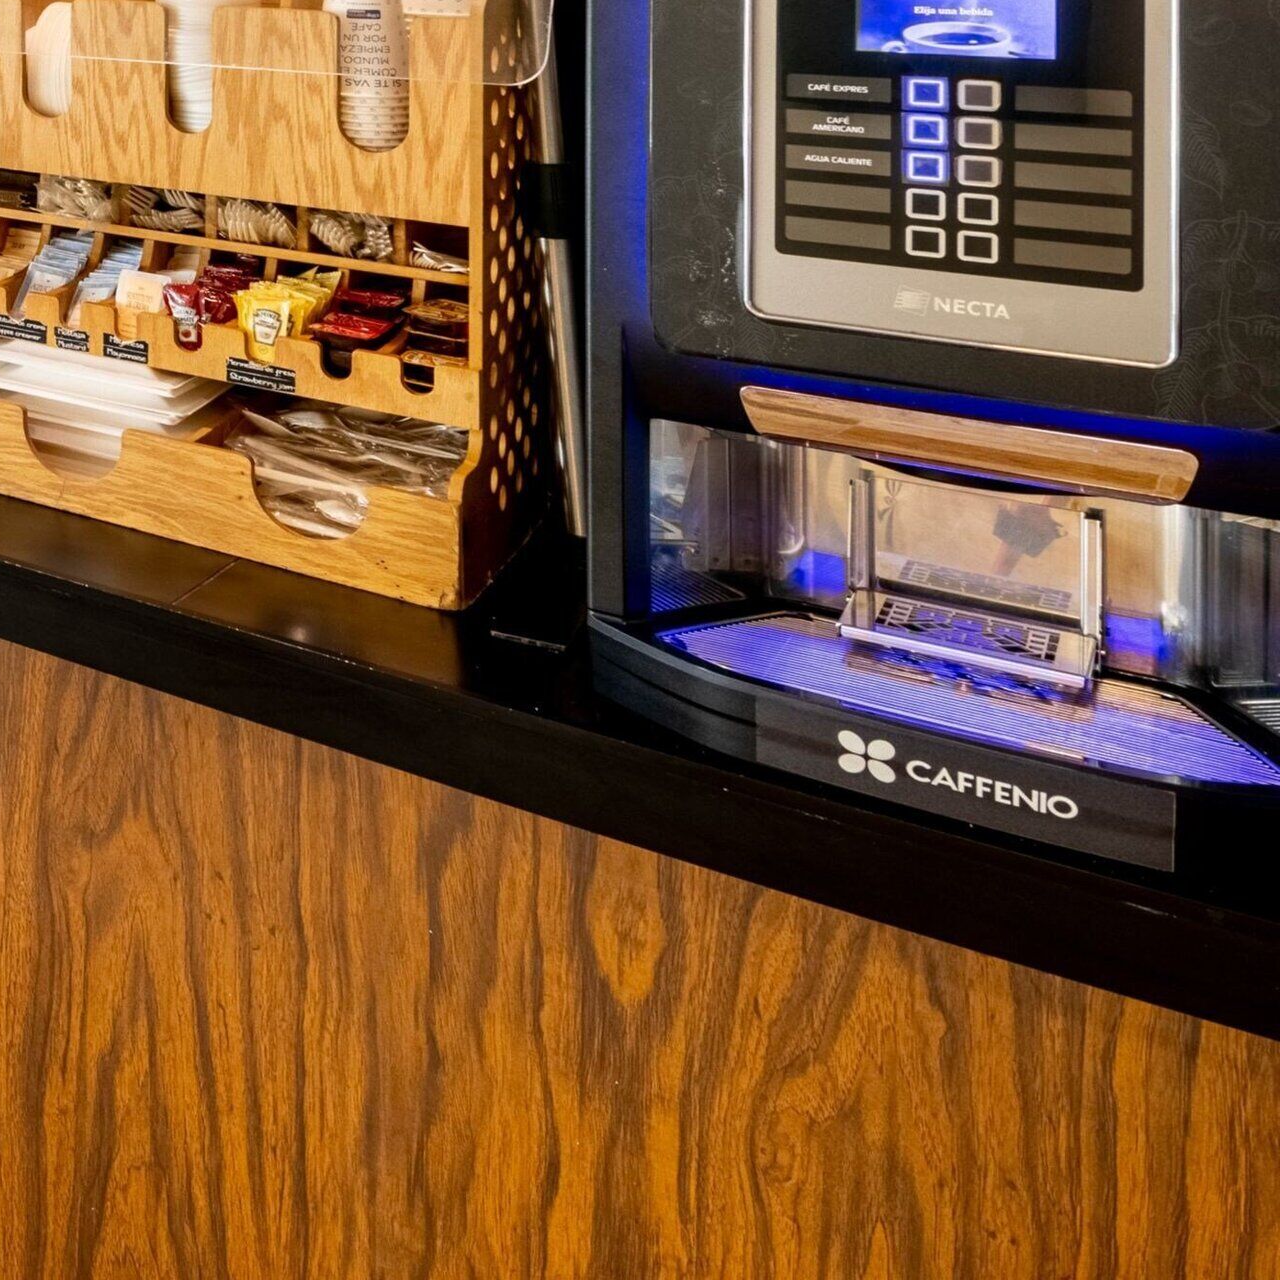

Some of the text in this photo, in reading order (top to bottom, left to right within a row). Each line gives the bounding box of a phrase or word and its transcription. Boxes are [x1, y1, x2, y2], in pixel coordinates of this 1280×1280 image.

[913, 6, 994, 17] Elija una bebida
[343, 34, 387, 42] POR UN
[340, 44, 391, 53] EMPIEZA
[344, 78, 402, 88] SI TE VAS
[807, 83, 869, 94] CAFÉ EXPRES
[826, 115, 850, 125] CAFÉ
[812, 123, 865, 134] AMERICANO
[804, 154, 873, 166] AGUA CALIENTE
[933, 296, 1010, 320] NECTA
[905, 760, 1079, 820] CAFFENIO
